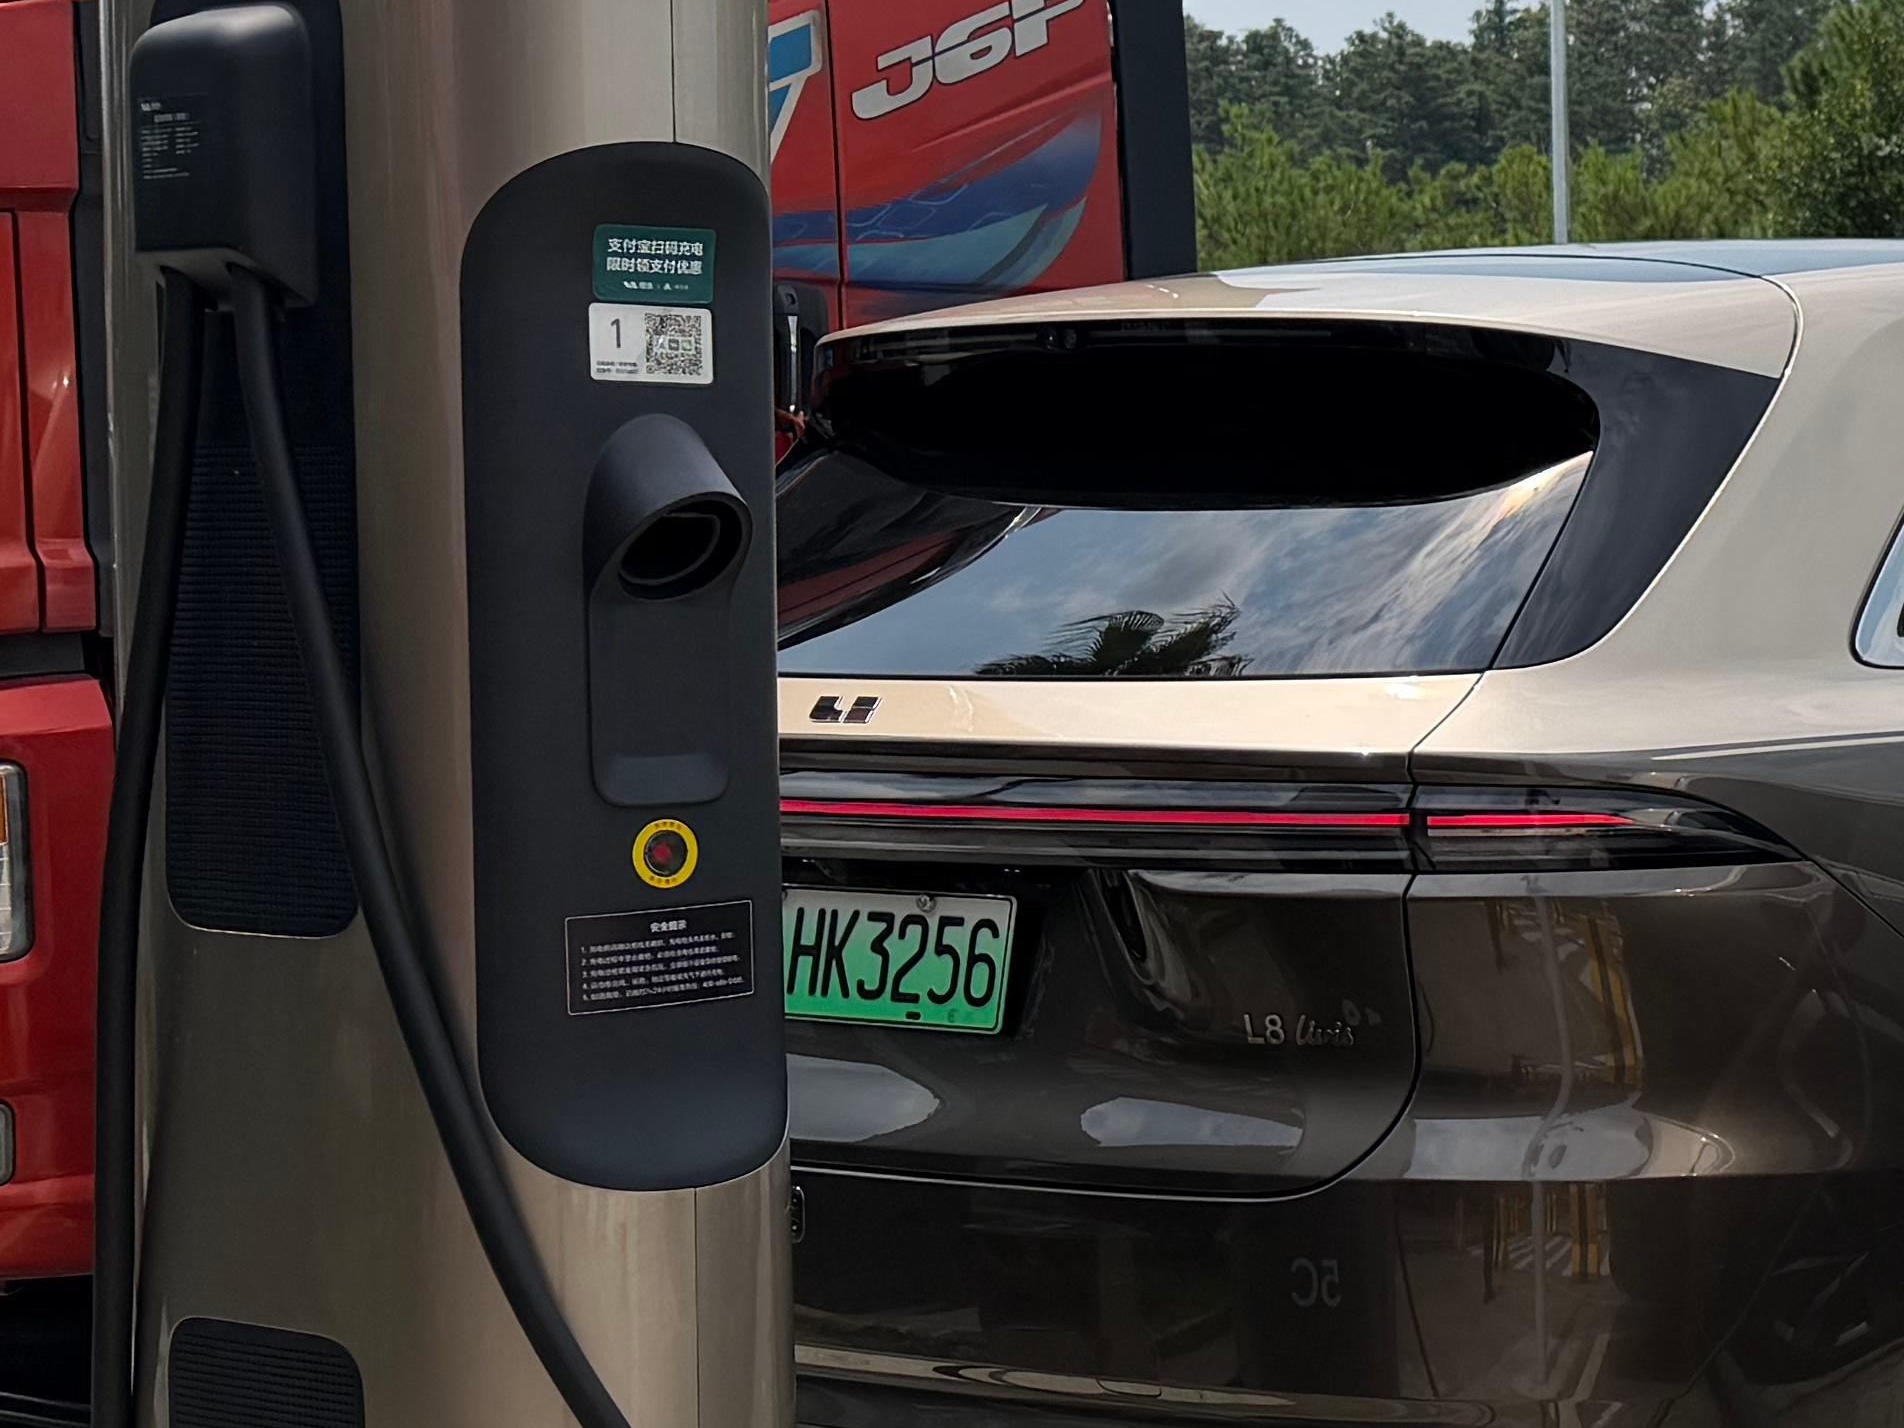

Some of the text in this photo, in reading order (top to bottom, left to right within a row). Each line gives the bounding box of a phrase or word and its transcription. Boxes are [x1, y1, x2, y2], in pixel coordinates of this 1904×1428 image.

[607, 237, 704, 257] 支付宝扫码充电
[606, 256, 703, 275] 限时领支付优惠
[610, 318, 621, 349] 1
[786, 907, 1000, 1008] HK3256
[1243, 1013, 1286, 1045] L8
